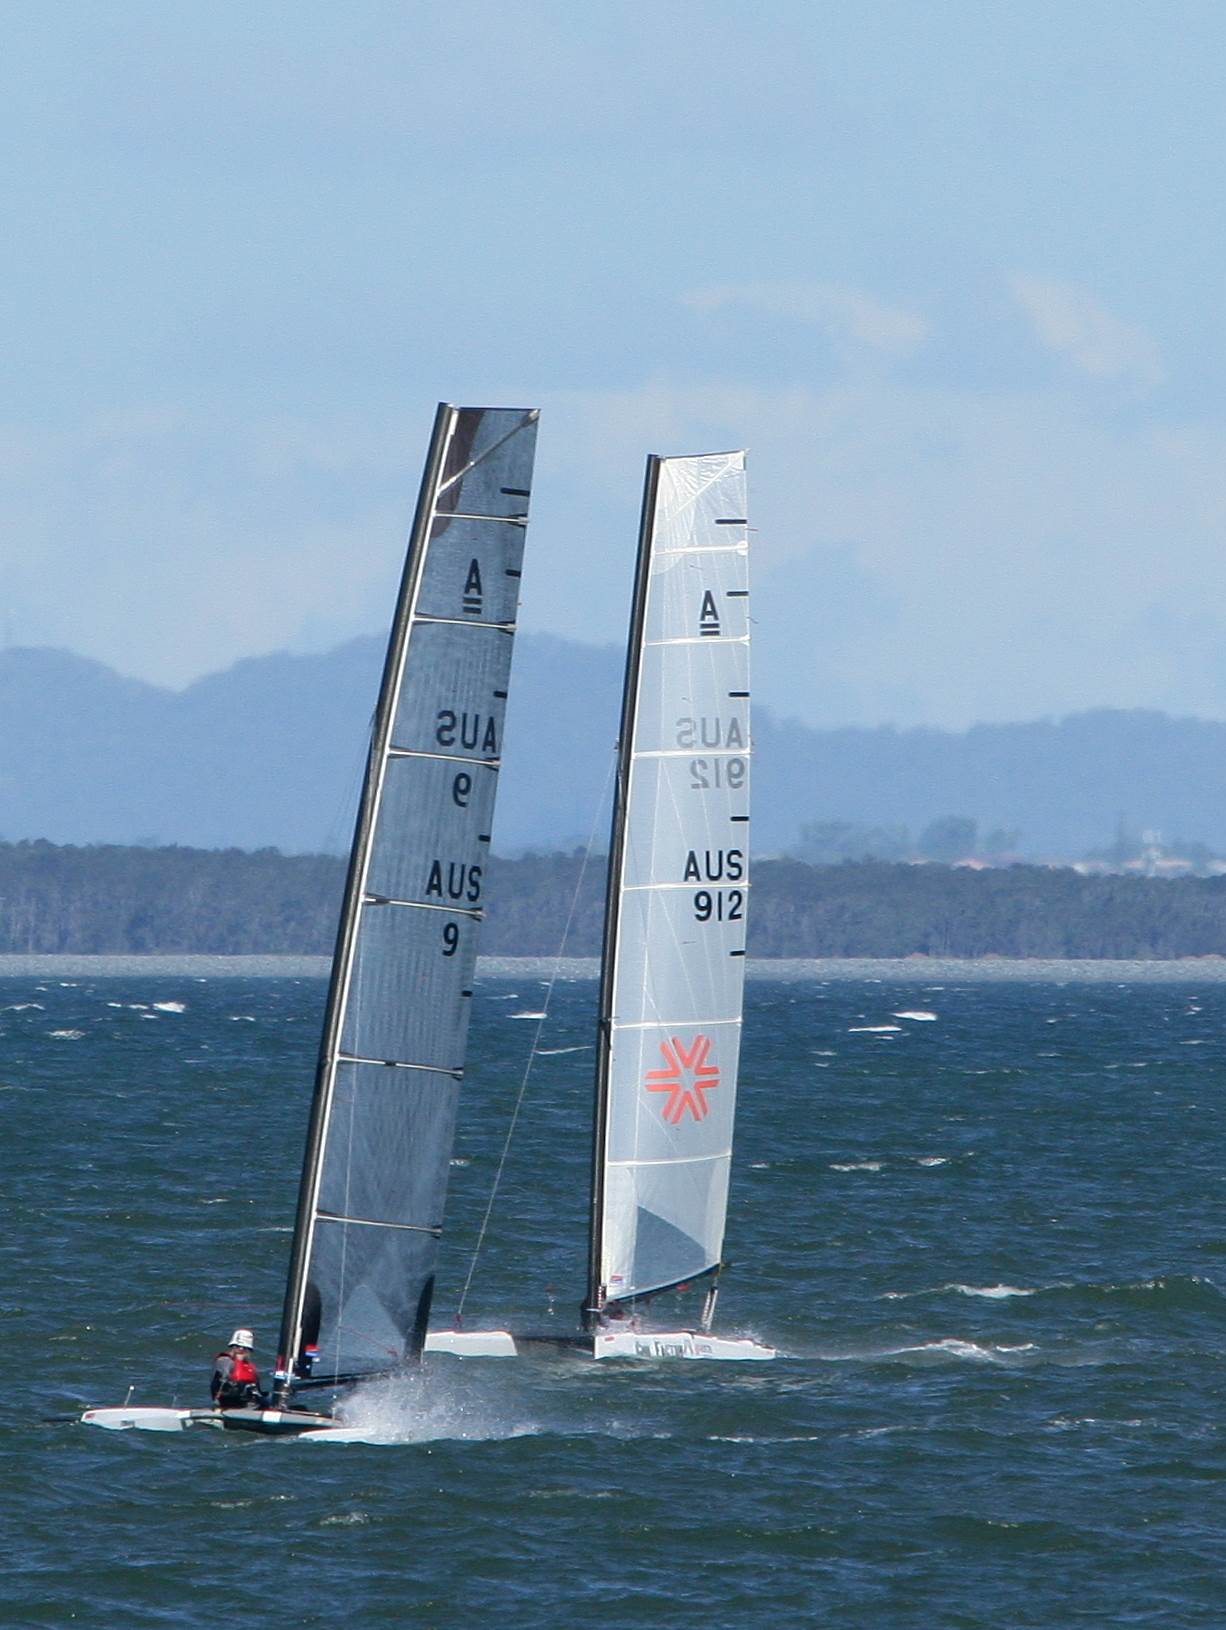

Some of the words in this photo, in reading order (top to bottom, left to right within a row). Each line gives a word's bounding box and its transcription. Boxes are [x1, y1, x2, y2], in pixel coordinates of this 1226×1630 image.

[464, 558, 483, 596] A
[700, 590, 719, 621] A
[426, 860, 482, 900] AUS
[684, 850, 743, 882] AUS
[694, 890, 742, 921] 912
[442, 922, 459, 957] 9
